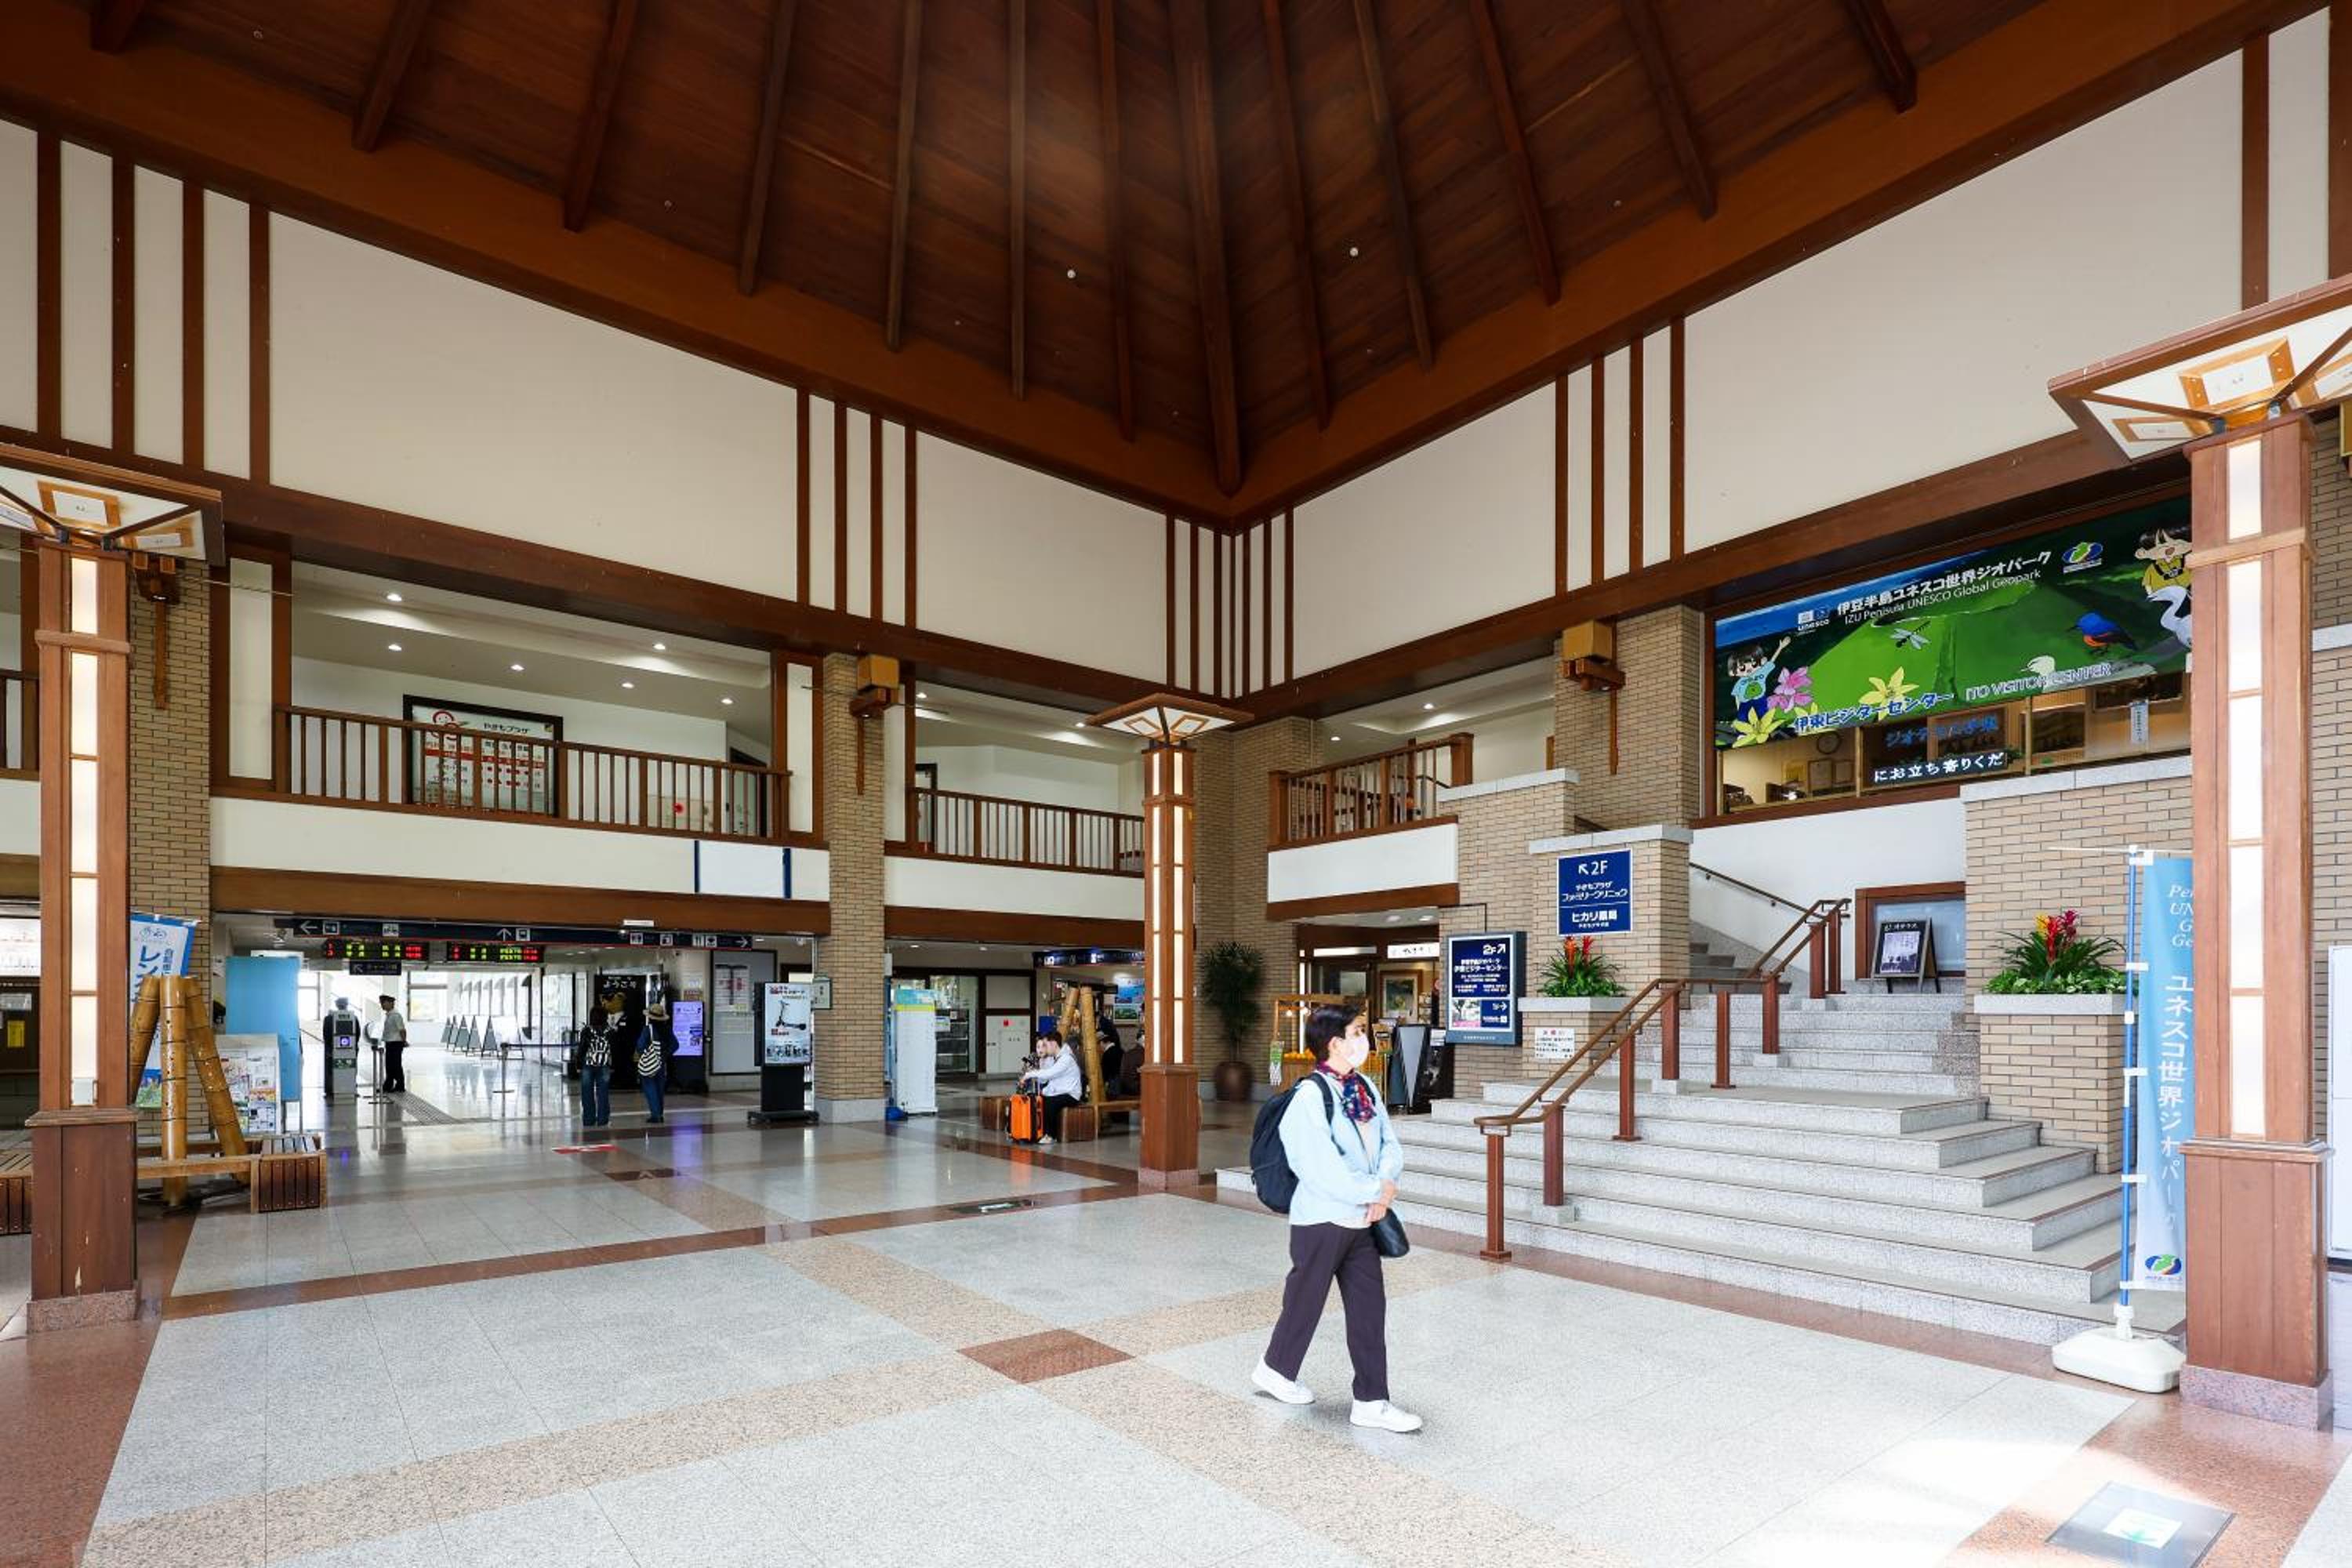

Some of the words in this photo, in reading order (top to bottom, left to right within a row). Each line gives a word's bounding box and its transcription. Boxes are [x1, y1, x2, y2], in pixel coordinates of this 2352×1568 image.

[1837, 551, 2052, 616] 伊豆半島ユネスコ世界ジオパーク
[1845, 612, 1862, 625] IZU
[1907, 591, 1951, 609] UNESCO
[1953, 580, 1989, 598] Global
[1992, 568, 2041, 590] Geopark
[1991, 675, 2049, 695] VISITOR
[2050, 662, 2112, 684] CENTER
[1794, 692, 1955, 731] 伊東ビジターセンター
[1874, 752, 2005, 782] にお立ち寄りくだ
[1592, 860, 1608, 876] 2F
[2158, 975, 2194, 1230] ユネスコ世界ジオパーク
